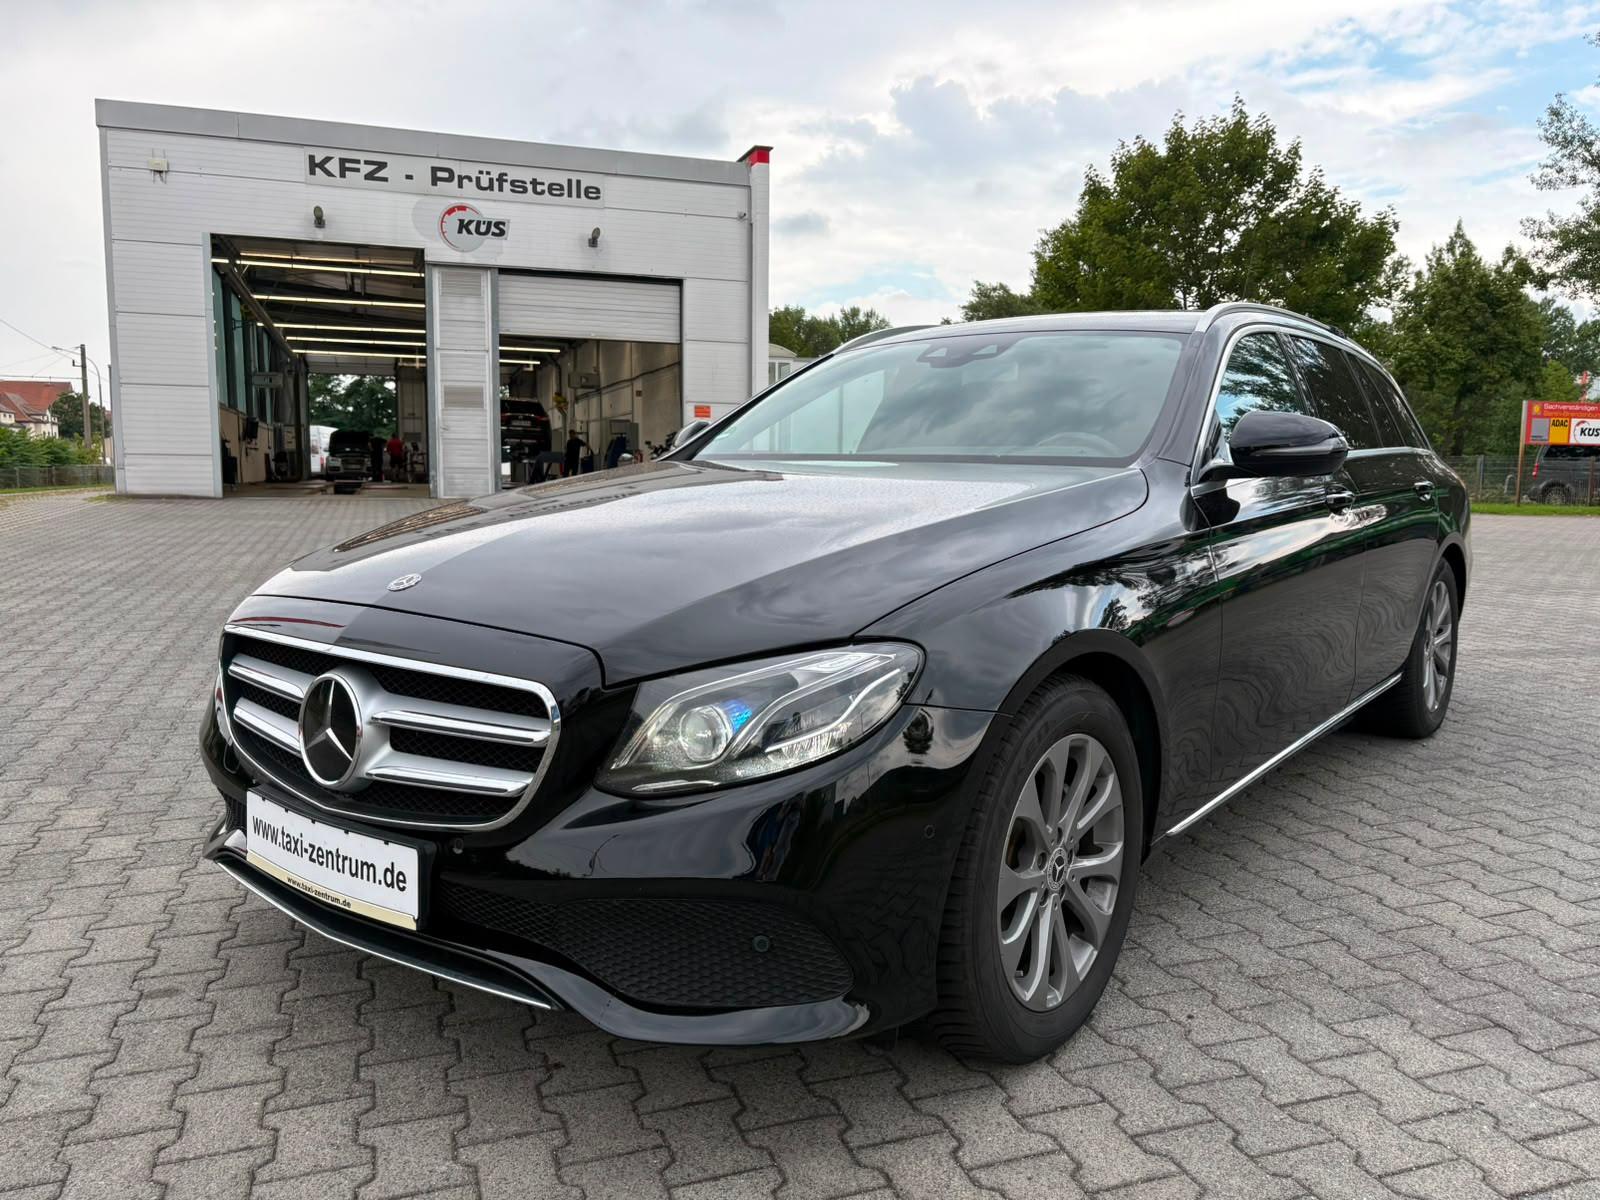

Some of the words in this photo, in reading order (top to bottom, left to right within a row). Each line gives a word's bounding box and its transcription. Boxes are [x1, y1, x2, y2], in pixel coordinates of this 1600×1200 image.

[308, 154, 389, 183] KFZ
[430, 165, 601, 201] Prüfstelle
[1551, 419, 1568, 428] ADAC
[252, 815, 407, 892] www.taxi-zentrum.de
[286, 875, 352, 909] www.taxi-zentrum.de
